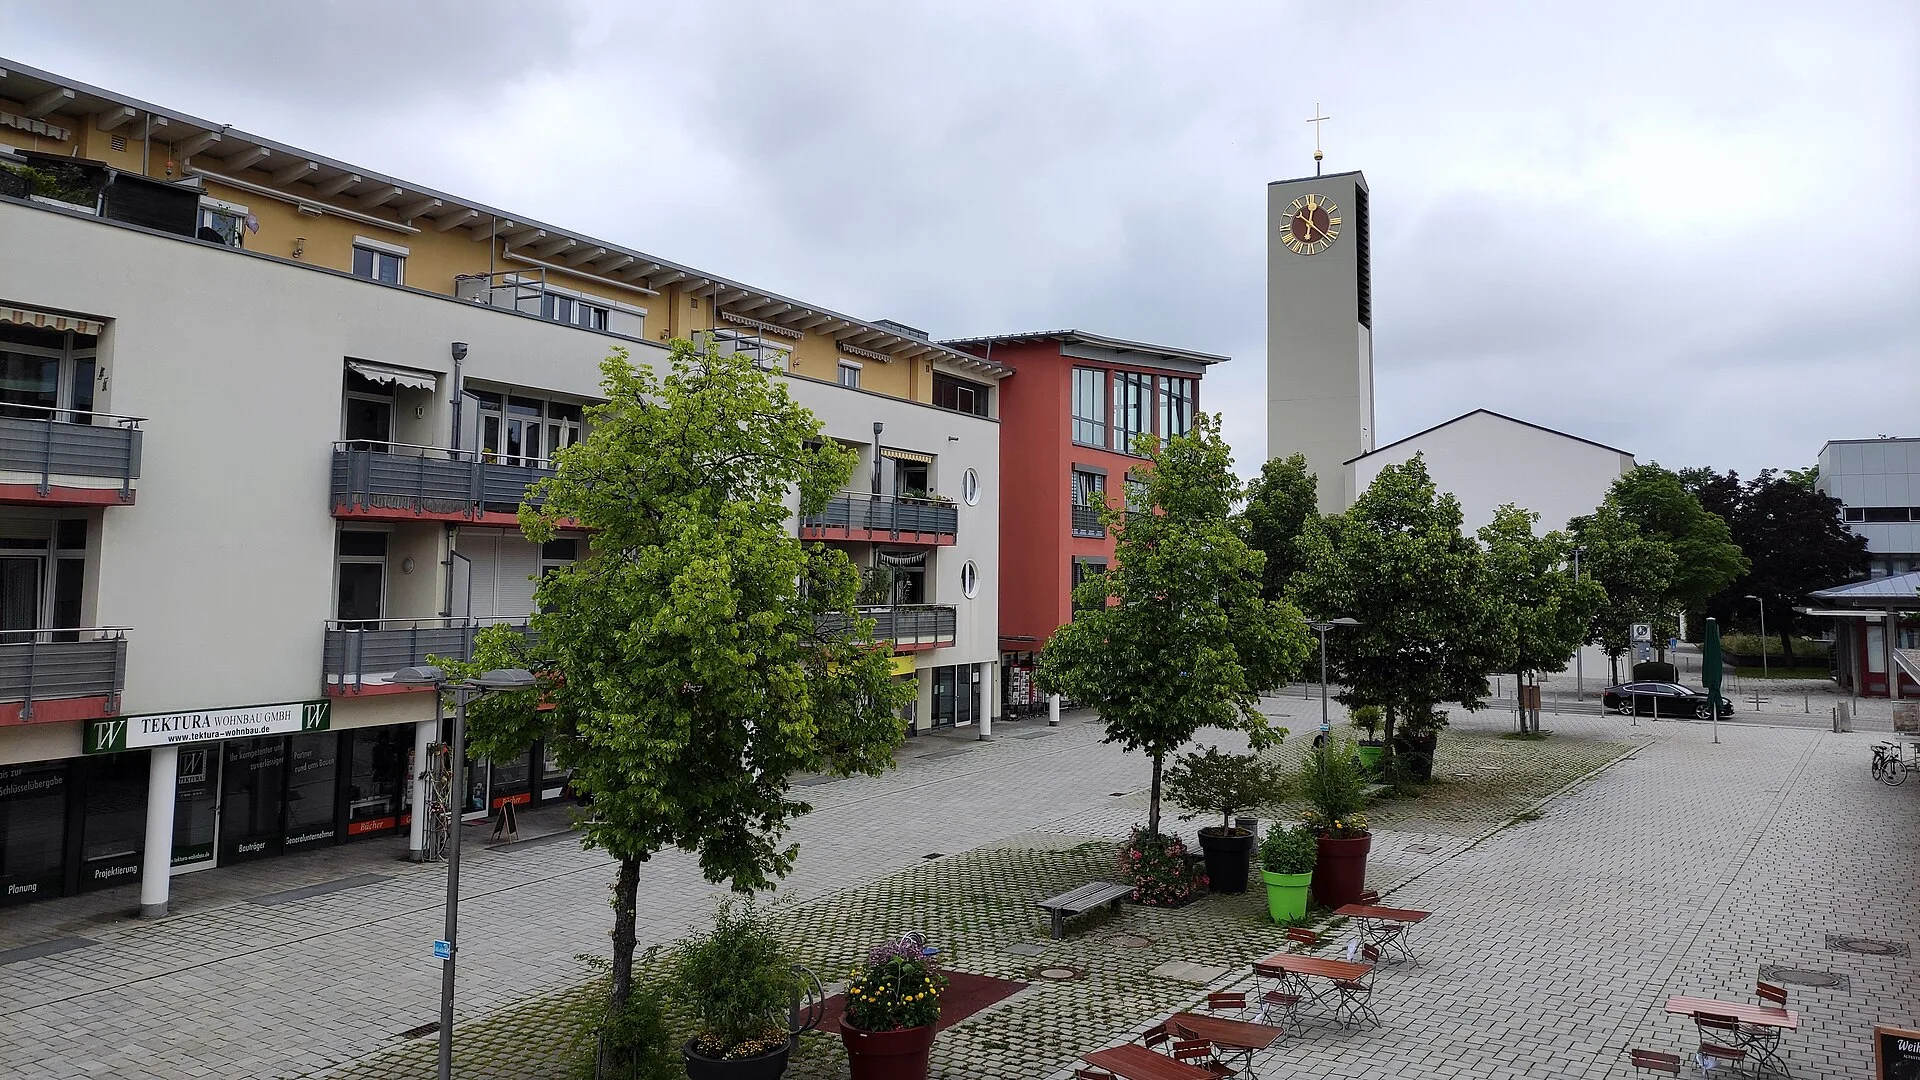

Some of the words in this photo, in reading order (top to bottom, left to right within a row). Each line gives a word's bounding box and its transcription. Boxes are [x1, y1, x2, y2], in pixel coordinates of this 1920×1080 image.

[141, 714, 211, 734] TEKTURA
[214, 712, 262, 727] WOHNBAU
[264, 710, 292, 723] GMBH
[304, 703, 329, 729] TW
[93, 720, 126, 751] TW
[168, 725, 270, 743] www.tektura-wohnbau.de
[229, 753, 238, 762] Ihr
[239, 746, 273, 760] kompetenter
[274, 741, 285, 751] und
[293, 750, 313, 760] Partner
[250, 757, 285, 771] zuverlässiger
[294, 763, 307, 773] rund
[307, 761, 319, 770] ums
[319, 758, 335, 767] Bauen
[10, 768, 23, 778] zur
[0, 776, 63, 797] Schlüsselübergabe
[360, 821, 384, 831] Bücher
[285, 830, 335, 845] Generalunternehmer
[238, 842, 266, 853] Bauträger
[94, 865, 138, 879] Projektierung
[8, 883, 37, 895] Planung
